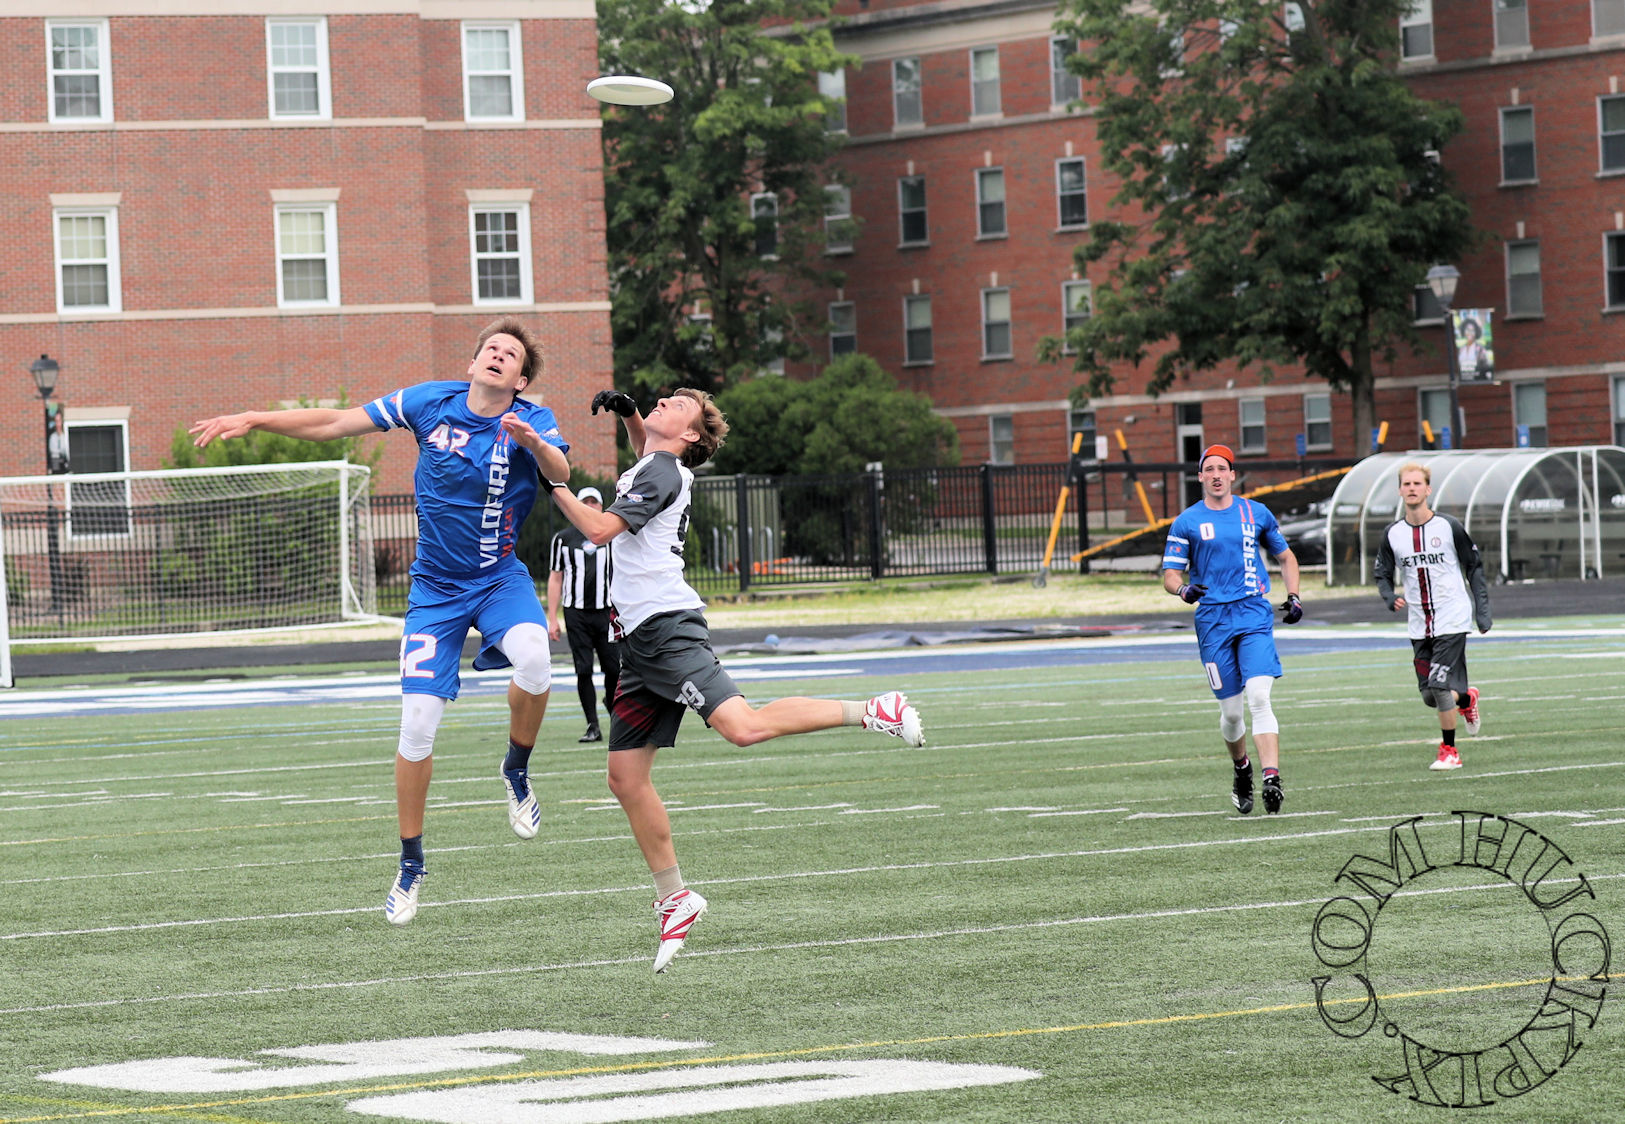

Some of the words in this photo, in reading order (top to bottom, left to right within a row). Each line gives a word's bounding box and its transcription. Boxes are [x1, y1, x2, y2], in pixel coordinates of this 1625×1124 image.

[428, 423, 470, 458] 42
[1199, 522, 1215, 541] 0
[1428, 662, 1451, 683] 76
